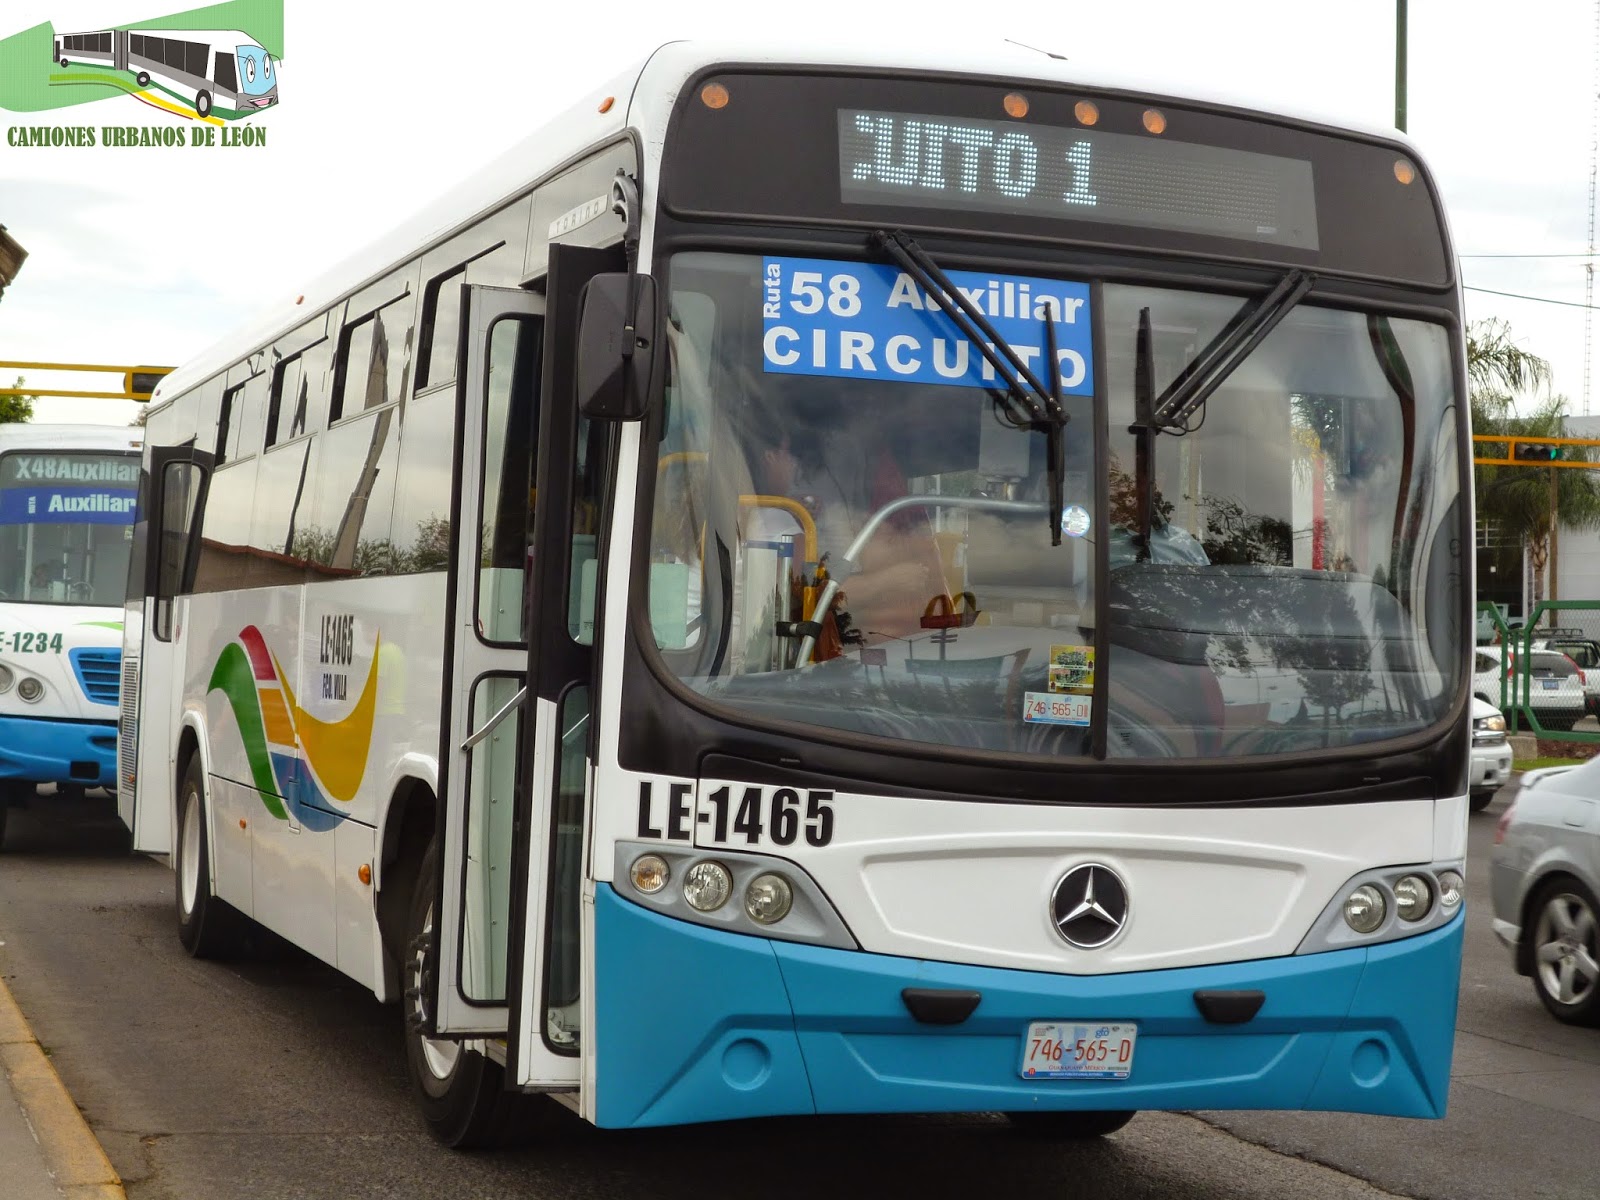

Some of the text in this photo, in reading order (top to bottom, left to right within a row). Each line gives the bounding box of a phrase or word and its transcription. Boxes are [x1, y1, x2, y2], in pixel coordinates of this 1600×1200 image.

[1063, 141, 1097, 206] 1
[556, 201, 599, 233] TORINO
[763, 264, 780, 318] Ruta
[790, 271, 862, 317] 58
[763, 326, 1086, 388] CIRCUITO
[48, 494, 136, 512] Auxiliar
[320, 615, 354, 665] LE-1465
[638, 781, 834, 848] LE-1465
[1030, 1039, 1131, 1063] 746-565-D
